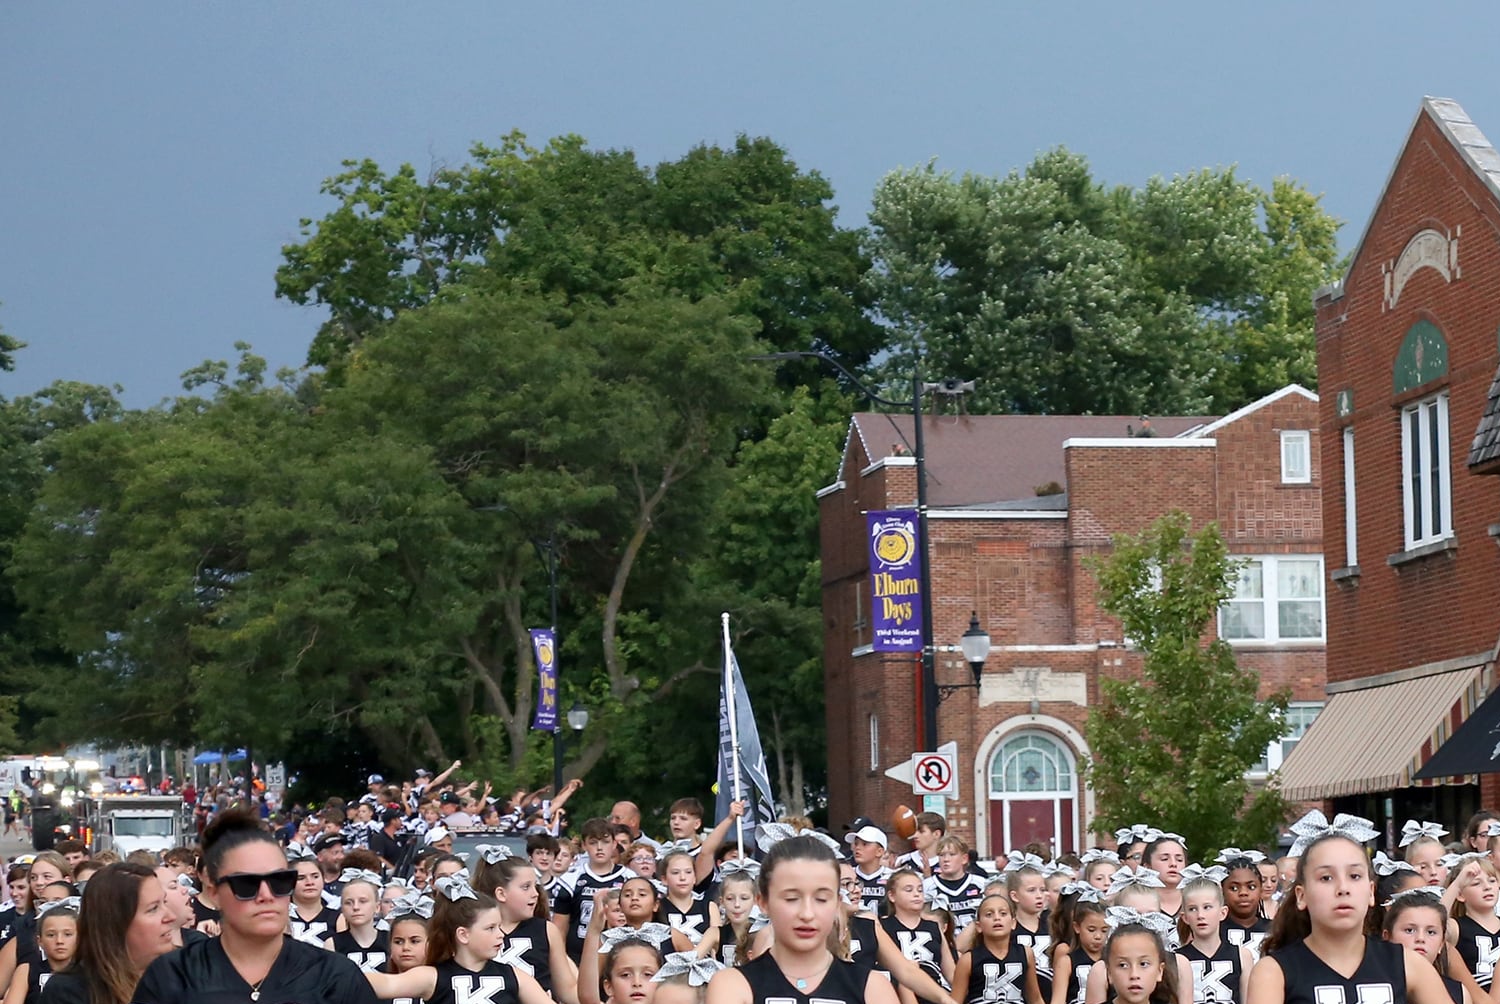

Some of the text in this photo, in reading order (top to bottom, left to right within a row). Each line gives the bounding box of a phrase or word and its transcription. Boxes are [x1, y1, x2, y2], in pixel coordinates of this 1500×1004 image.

[873, 572, 919, 597] Elburn
[882, 597, 912, 625] Days
[290, 922, 327, 948] K
[668, 913, 704, 946] K
[897, 931, 934, 961] K
[1228, 929, 1266, 963] K
[1017, 935, 1050, 970] K
[983, 963, 1023, 1000] K
[1190, 960, 1234, 1002] K
